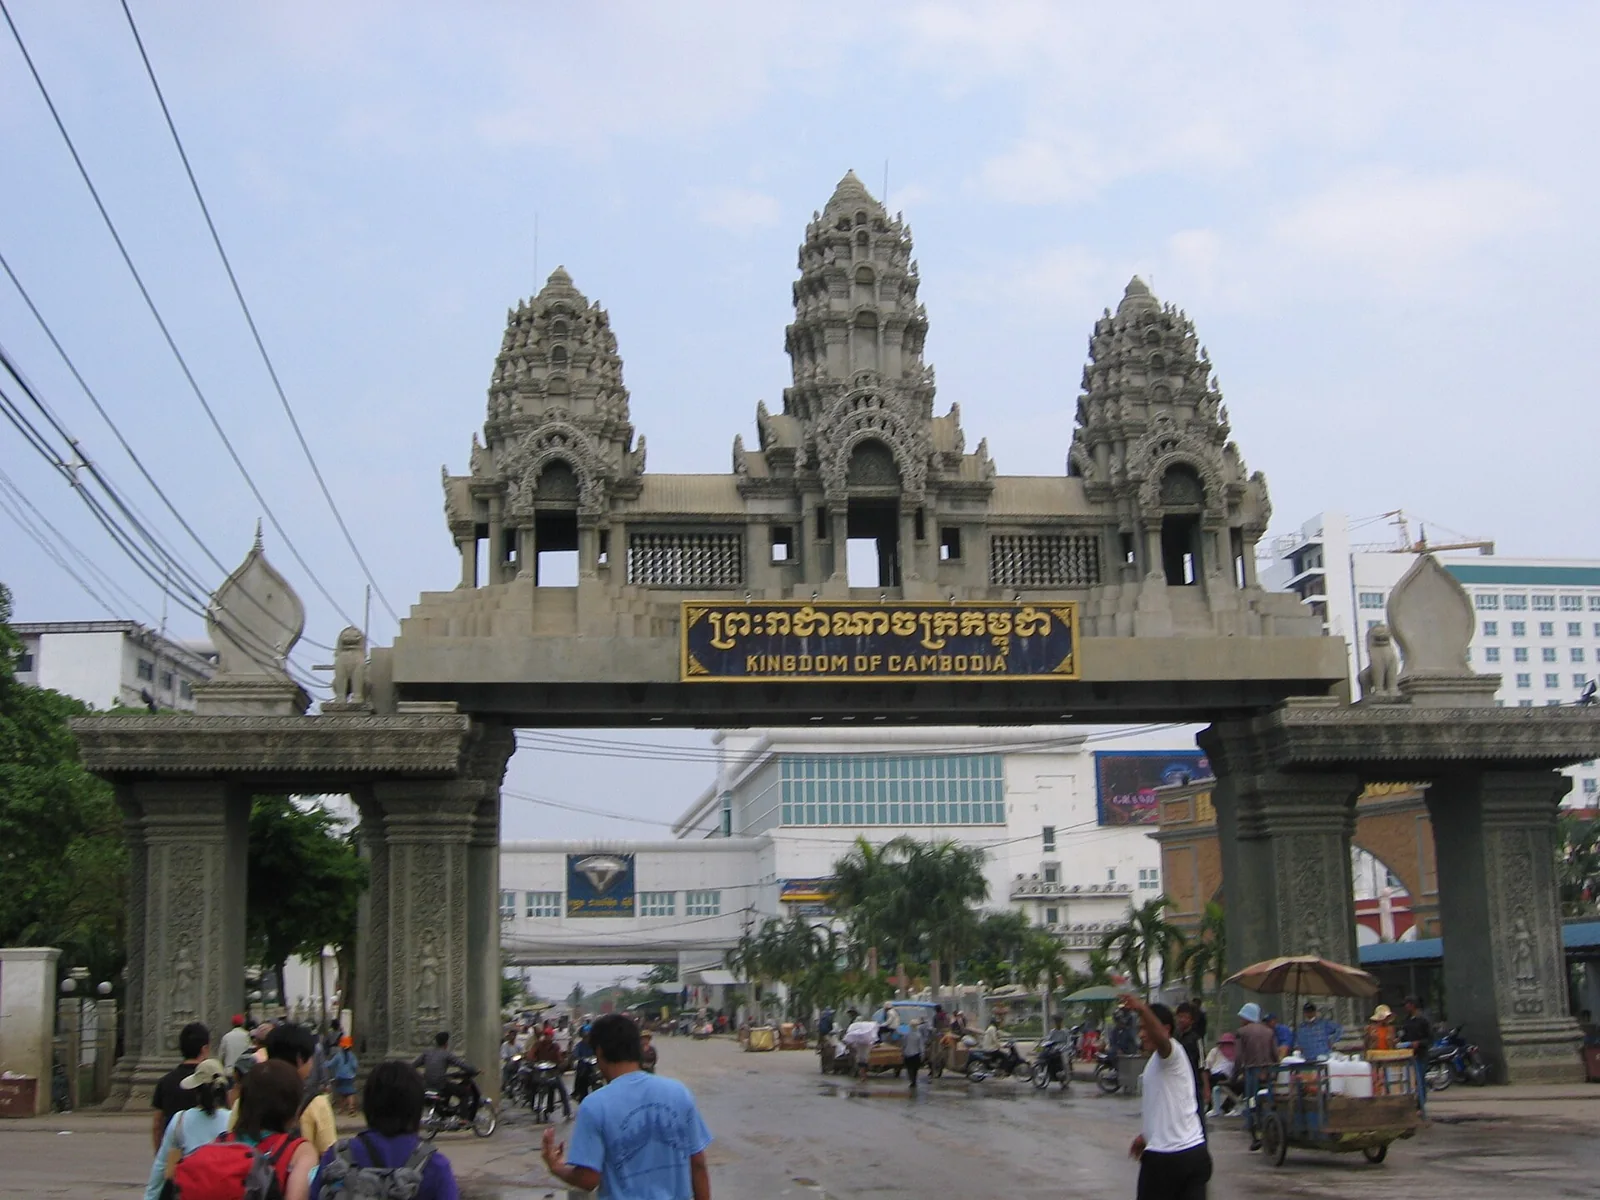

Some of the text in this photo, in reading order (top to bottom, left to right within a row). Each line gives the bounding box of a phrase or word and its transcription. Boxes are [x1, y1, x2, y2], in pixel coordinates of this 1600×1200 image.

[746, 654, 1007, 673] KINGDOM OF CAMBODIA
